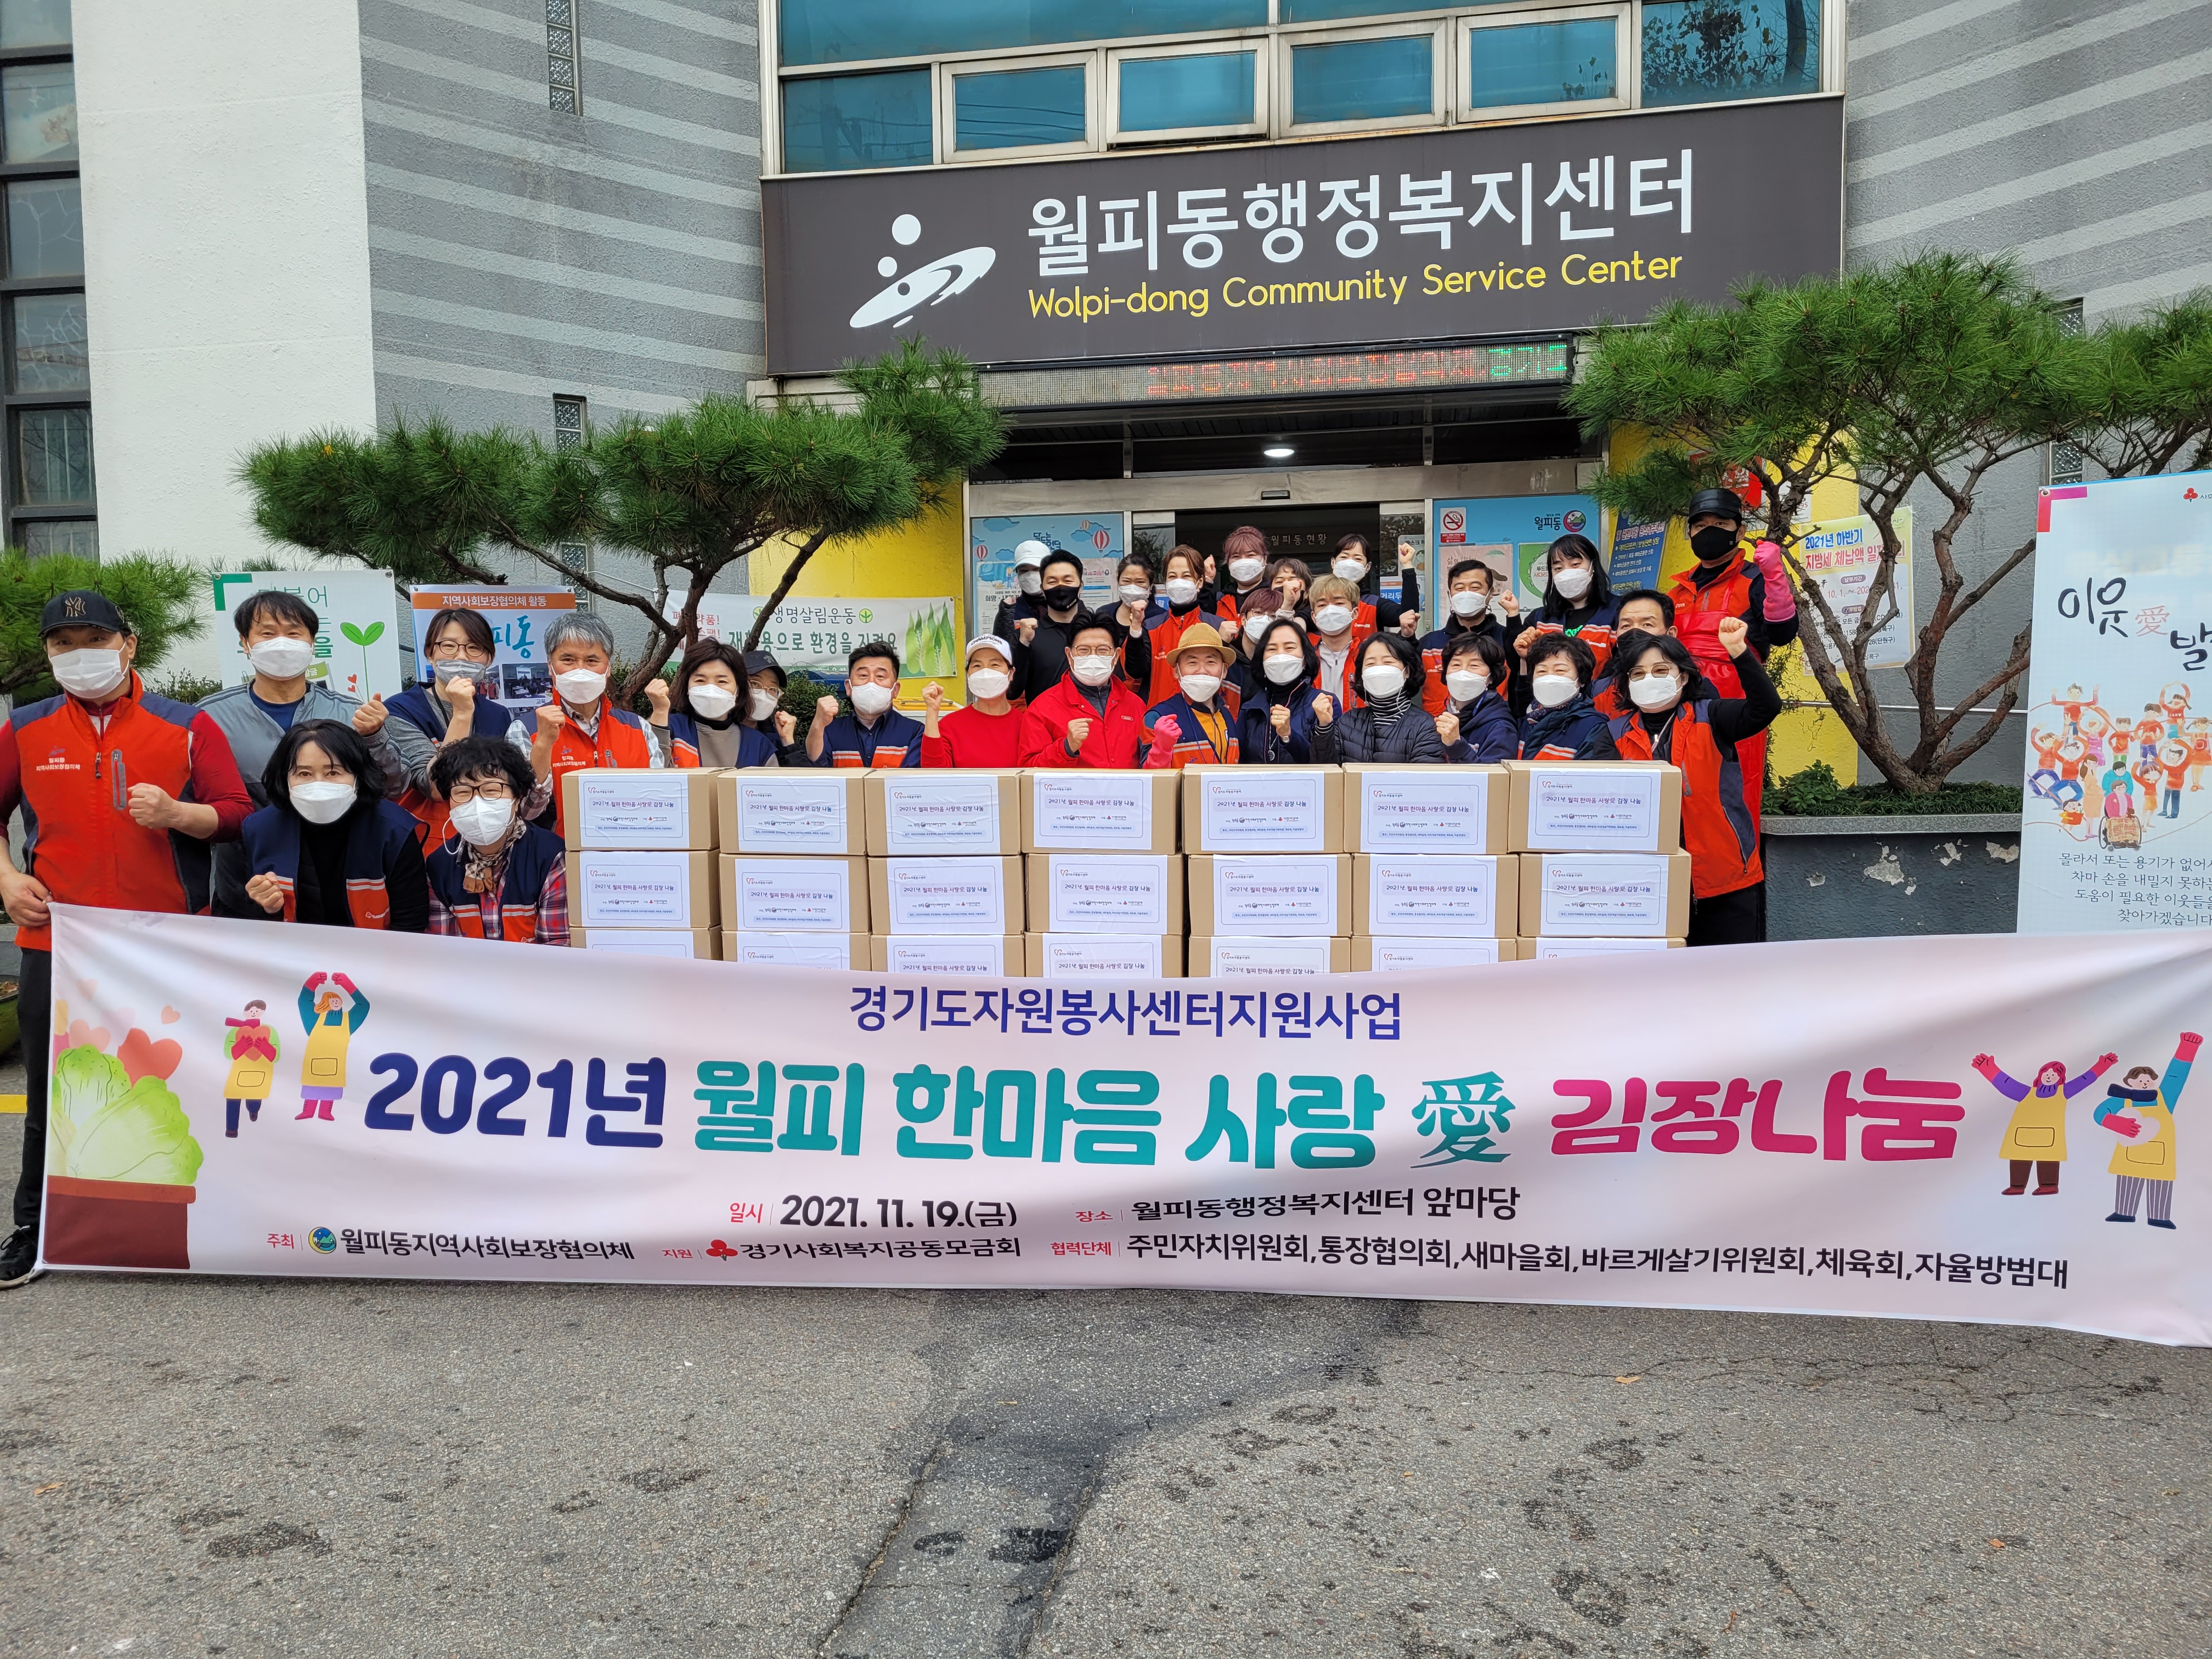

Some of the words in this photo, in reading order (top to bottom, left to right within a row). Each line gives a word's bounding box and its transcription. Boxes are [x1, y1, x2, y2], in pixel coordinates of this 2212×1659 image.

[1028, 149, 1694, 276] 월피동행정복지센터
[1029, 282, 1208, 323] Wolpi-dong
[1223, 269, 1407, 307] Community
[1423, 262, 1545, 292] Service
[1562, 251, 1682, 284] Center
[1534, 517, 1561, 531] 월피동
[1271, 534, 1302, 546] 월피동
[1306, 533, 1327, 545] 현황
[1805, 532, 1834, 550] 2021년
[1837, 528, 1863, 547] 하반기
[1805, 553, 1831, 571] 지방세
[1834, 548, 1865, 567] 체납액
[65, 597, 86, 617] NY
[442, 595, 527, 607] 지역사회보장협의체
[528, 595, 547, 606] 활동
[772, 606, 856, 625] 생명살림운동
[729, 631, 805, 653] 재용으로
[810, 630, 851, 655] 환경을
[2058, 853, 2098, 866] 몰라서
[2102, 855, 2130, 868] 또는
[2134, 856, 2175, 870] 용기가
[2072, 871, 2098, 883] 차마
[2102, 872, 2129, 887] 손을
[2134, 874, 2173, 888] 내밀지
[2074, 889, 2114, 902] 도움이
[2119, 891, 2159, 906] 필요한
[849, 986, 1400, 1040] 경기도자원봉사센터지원사업
[364, 1052, 667, 1149] 2021년
[693, 1060, 865, 1156] 월피
[893, 1063, 1162, 1166] 한마음
[1184, 1072, 1385, 1170] 사랑
[1409, 1070, 1516, 1169] 愛
[730, 1202, 762, 1224] 일시
[780, 1195, 868, 1228] 2021.
[876, 1198, 914, 1228] 11.
[922, 1200, 1018, 1228] 19.(금)
[1075, 1208, 1114, 1223] 장소
[1131, 1188, 1414, 1222] 월피동행정복지센터
[1423, 1186, 1521, 1221] 앞마당
[267, 1232, 295, 1249] 주최
[340, 1228, 635, 1260] 월피동지역사회보장협의체
[661, 1247, 694, 1260] 지원
[740, 1237, 1021, 1260] 경기사회복지공동모금회
[1050, 1240, 1112, 1257] 협력단체
